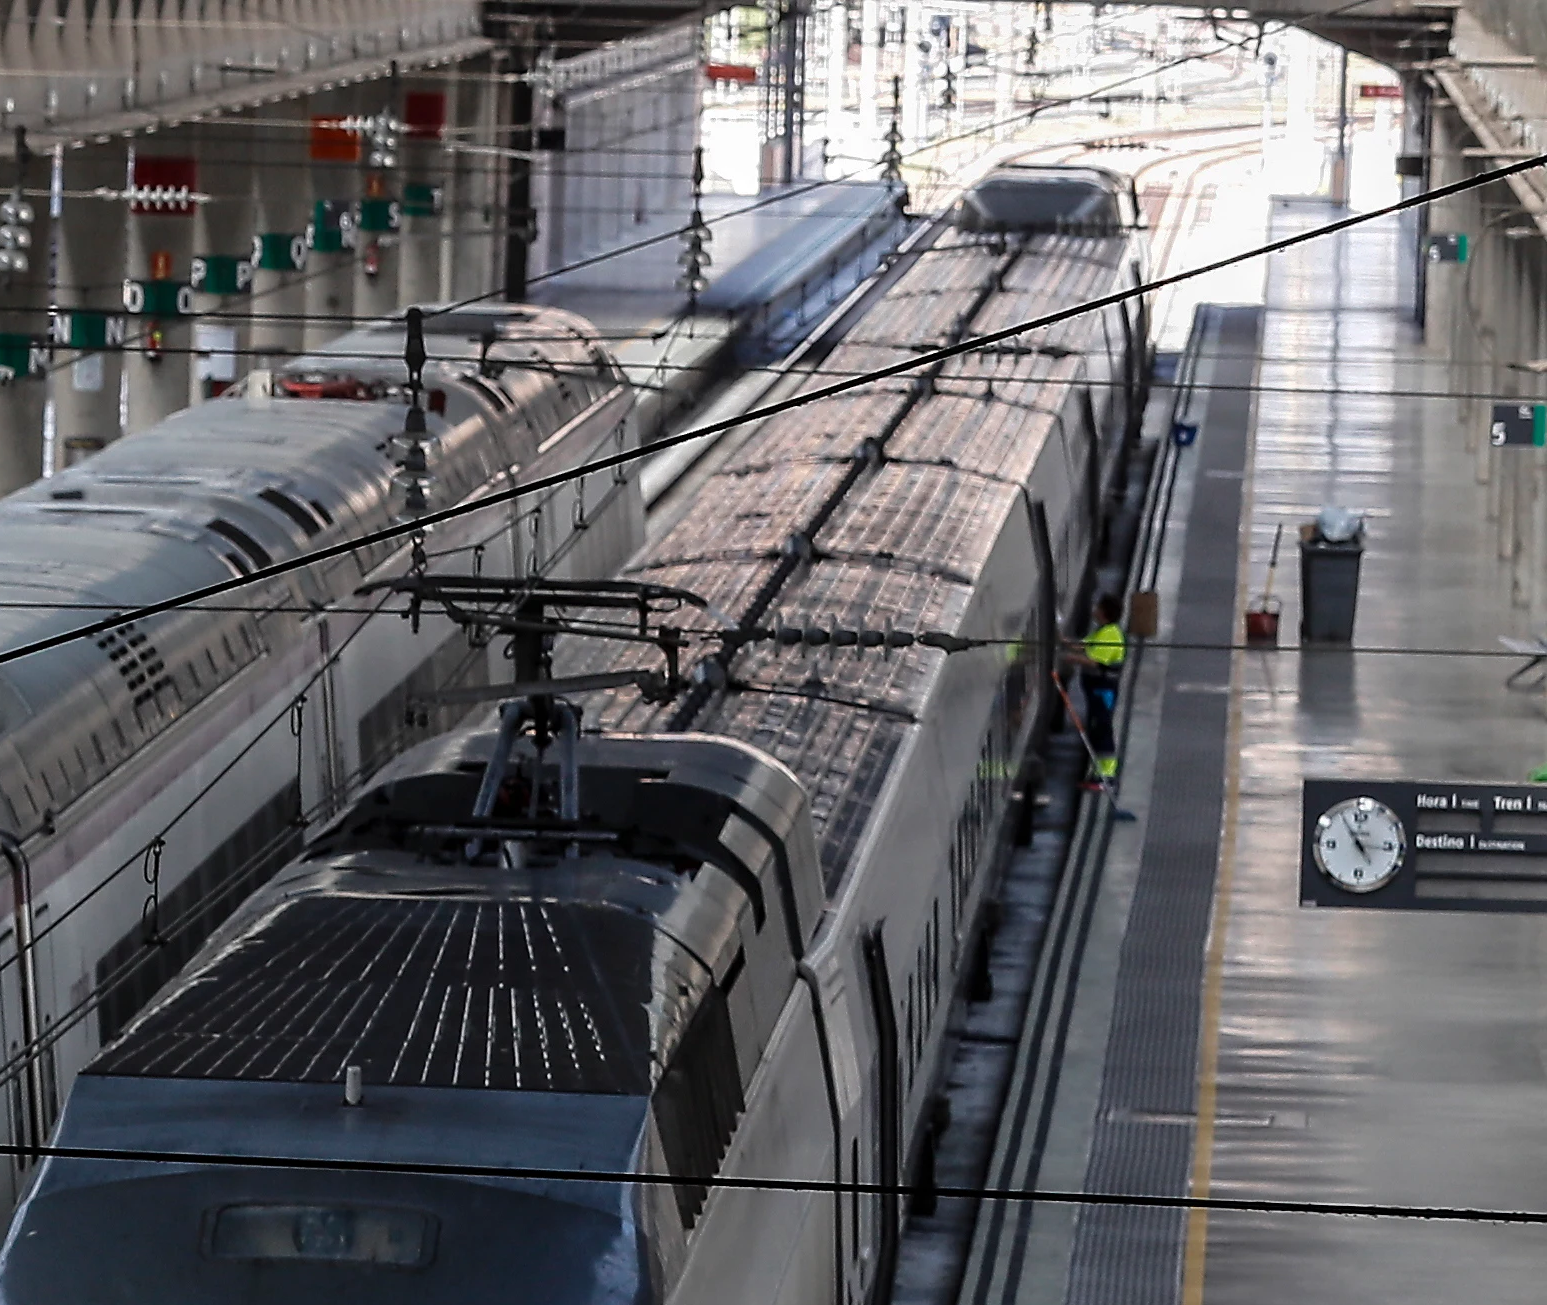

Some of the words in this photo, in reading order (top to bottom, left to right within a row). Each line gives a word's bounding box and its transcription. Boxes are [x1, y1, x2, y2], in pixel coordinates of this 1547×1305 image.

[1491, 421, 1507, 447] 5
[1416, 794, 1447, 809] Hora
[1493, 796, 1522, 811] Tren
[1415, 834, 1465, 850] Destino
